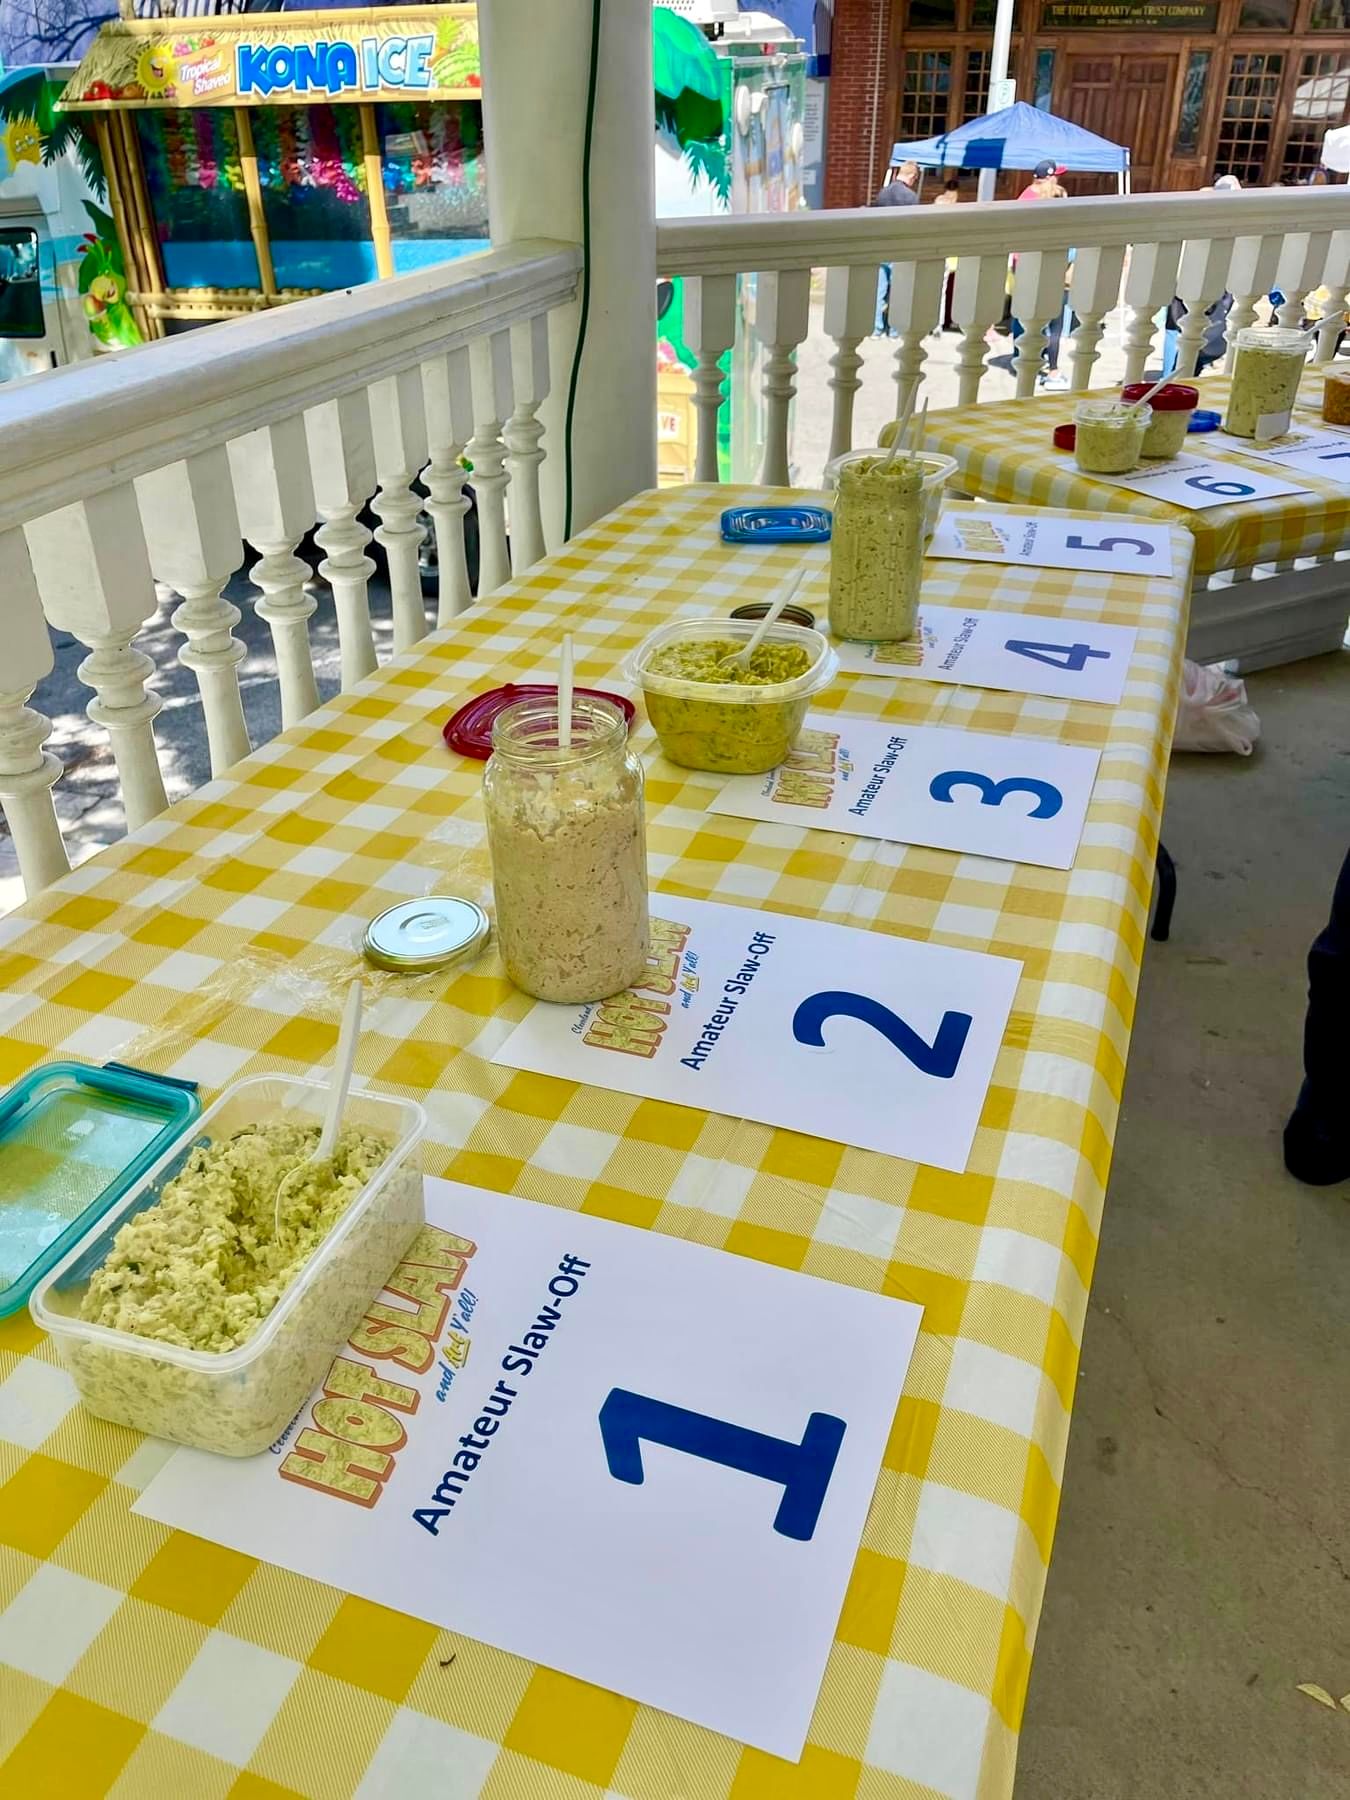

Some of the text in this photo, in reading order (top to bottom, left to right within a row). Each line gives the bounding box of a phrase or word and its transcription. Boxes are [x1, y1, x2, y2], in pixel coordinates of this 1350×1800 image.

[180, 56, 222, 80] Tropical
[194, 67, 231, 95] Shaved
[237, 34, 433, 95] KONA ICE
[1185, 476, 1256, 496] 6
[1066, 535, 1155, 556] 5
[1004, 639, 1111, 671] 4
[848, 736, 908, 816] Amateur Slaw-Off
[929, 770, 1063, 820] 3
[582, 990, 672, 1059] HOT
[680, 988, 693, 1009] and
[680, 931, 777, 1071] Amateur Slaw-Off
[792, 990, 974, 1079] 2
[278, 1222, 478, 1510] HOT SLAW
[435, 1287, 479, 1402] and Art Y'all!
[412, 1253, 592, 1537] Amateur Slaw-Off
[599, 1387, 848, 1542] 1
